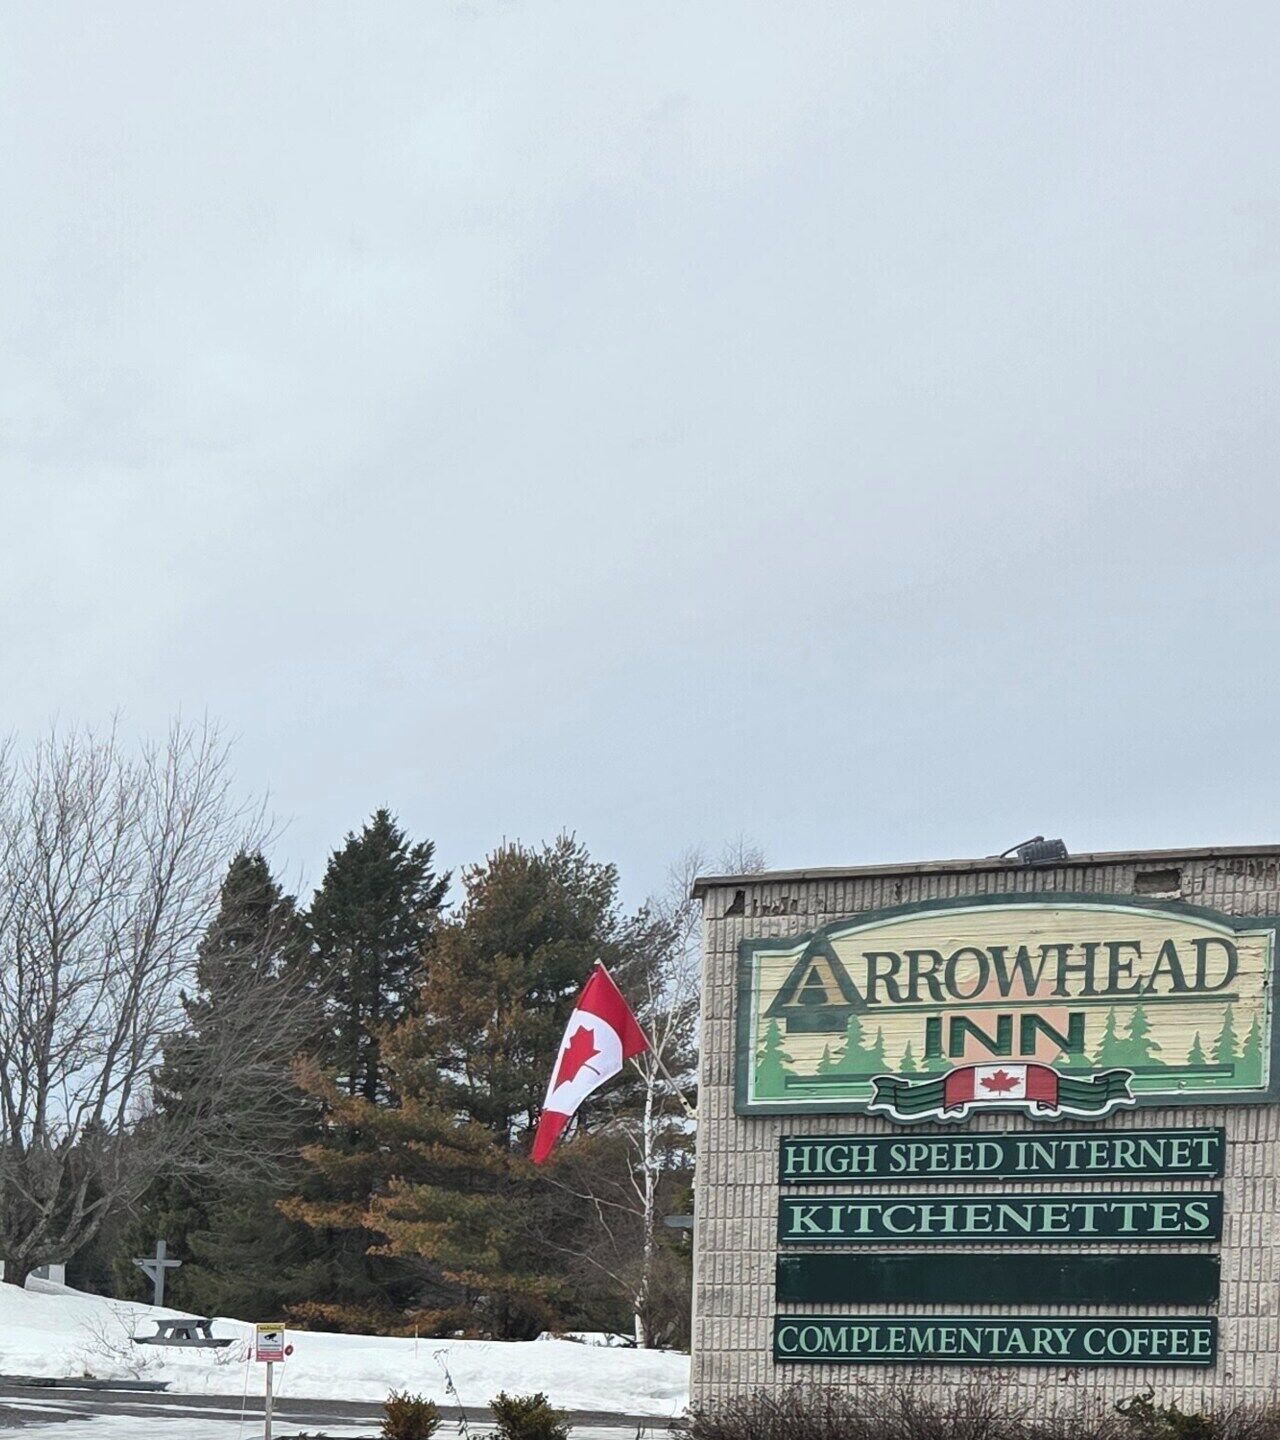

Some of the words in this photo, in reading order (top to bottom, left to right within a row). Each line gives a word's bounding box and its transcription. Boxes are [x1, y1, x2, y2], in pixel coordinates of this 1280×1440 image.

[763, 936, 1240, 1018] ARROWHEAD
[926, 1012, 1086, 1058] INN
[785, 1144, 877, 1174] HIGH
[889, 1141, 1004, 1172] SPEED
[1015, 1136, 1220, 1171] INTERNET
[787, 1201, 1211, 1234] KITCHENETTES
[778, 1325, 1078, 1355] COMPLEMENTARY
[1083, 1328, 1212, 1355] COFFEE
